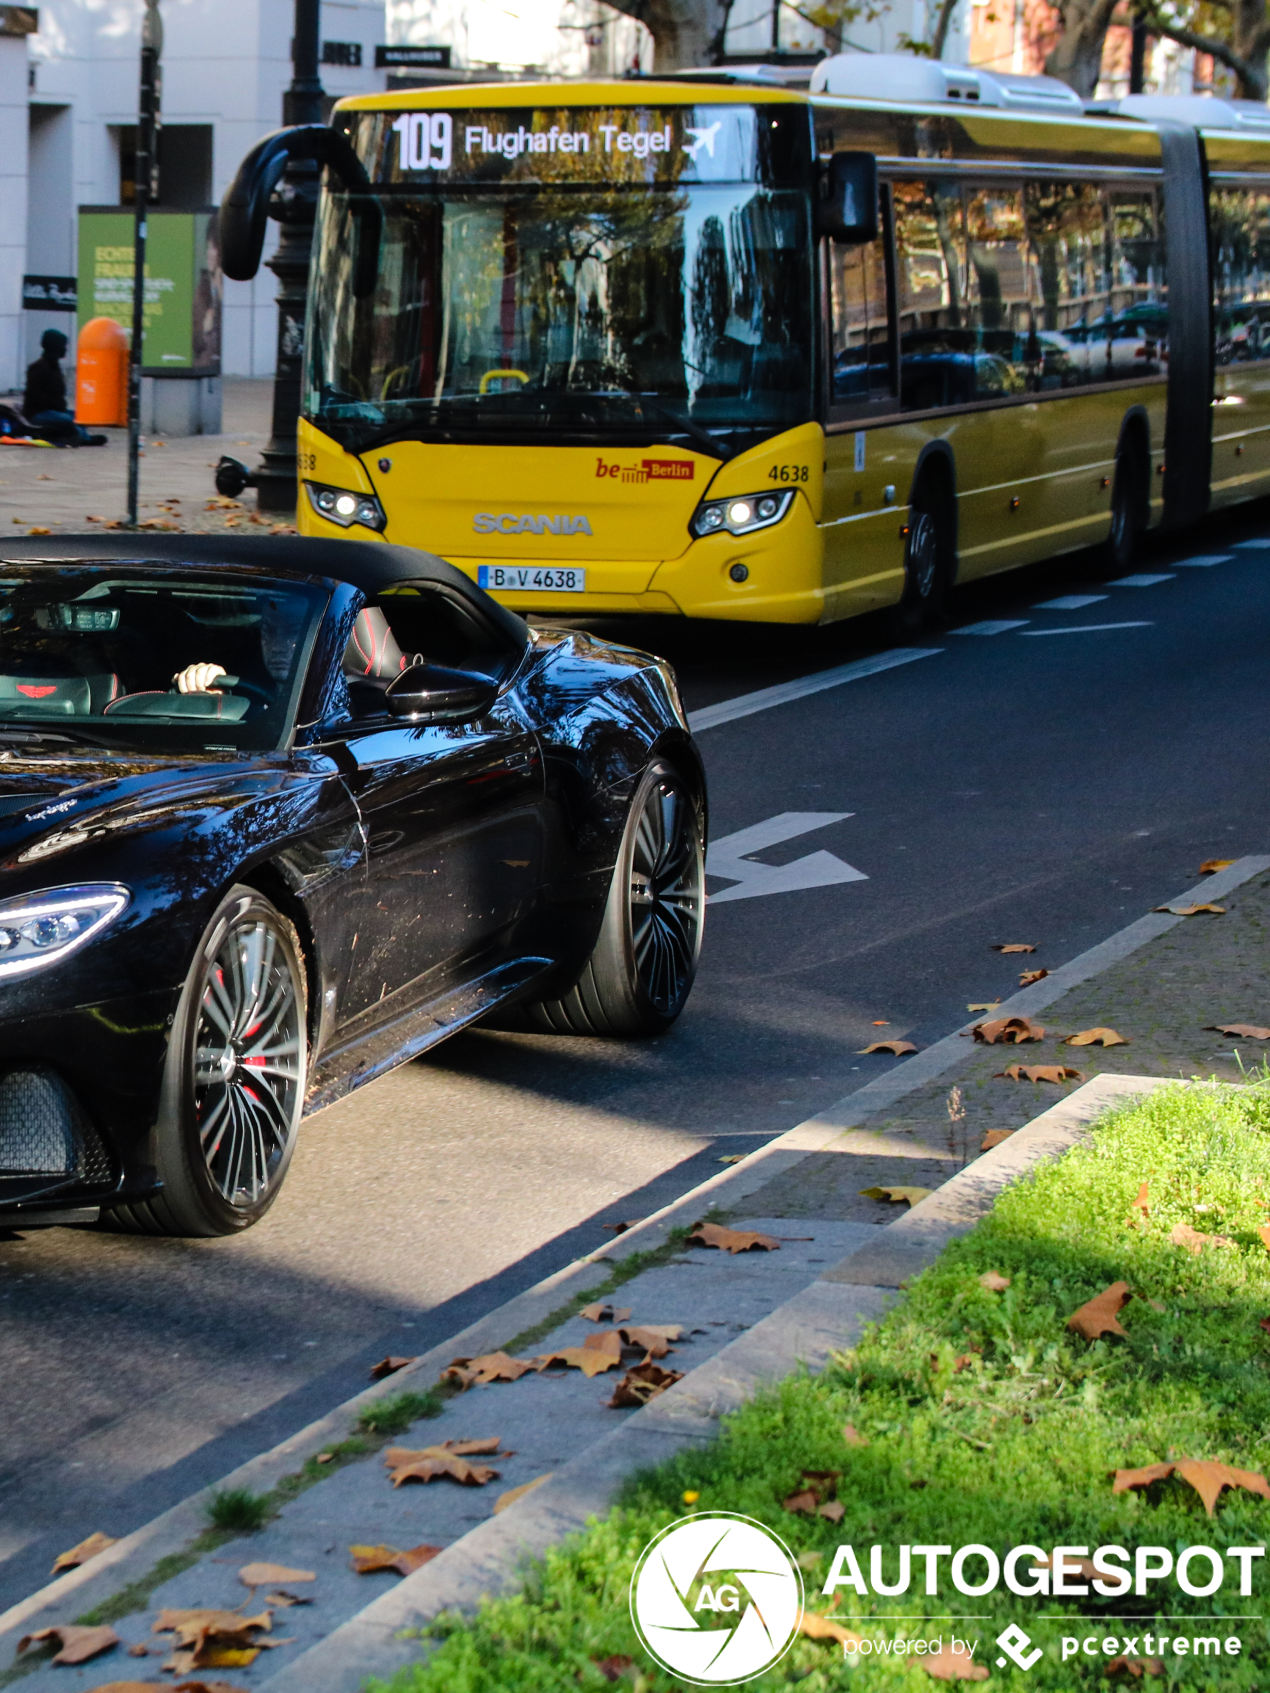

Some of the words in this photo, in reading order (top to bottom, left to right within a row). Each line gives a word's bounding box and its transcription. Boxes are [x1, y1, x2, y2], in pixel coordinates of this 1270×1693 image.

[392, 113, 452, 170] 109
[465, 125, 589, 159] Flughafen
[599, 125, 671, 158] Tegel
[596, 458, 620, 478] be
[651, 464, 690, 477] Berlin
[768, 465, 809, 482] 4638
[472, 513, 593, 536] SCANIA
[494, 569, 505, 586] B
[518, 570, 528, 586] V
[533, 571, 576, 588] 4638
